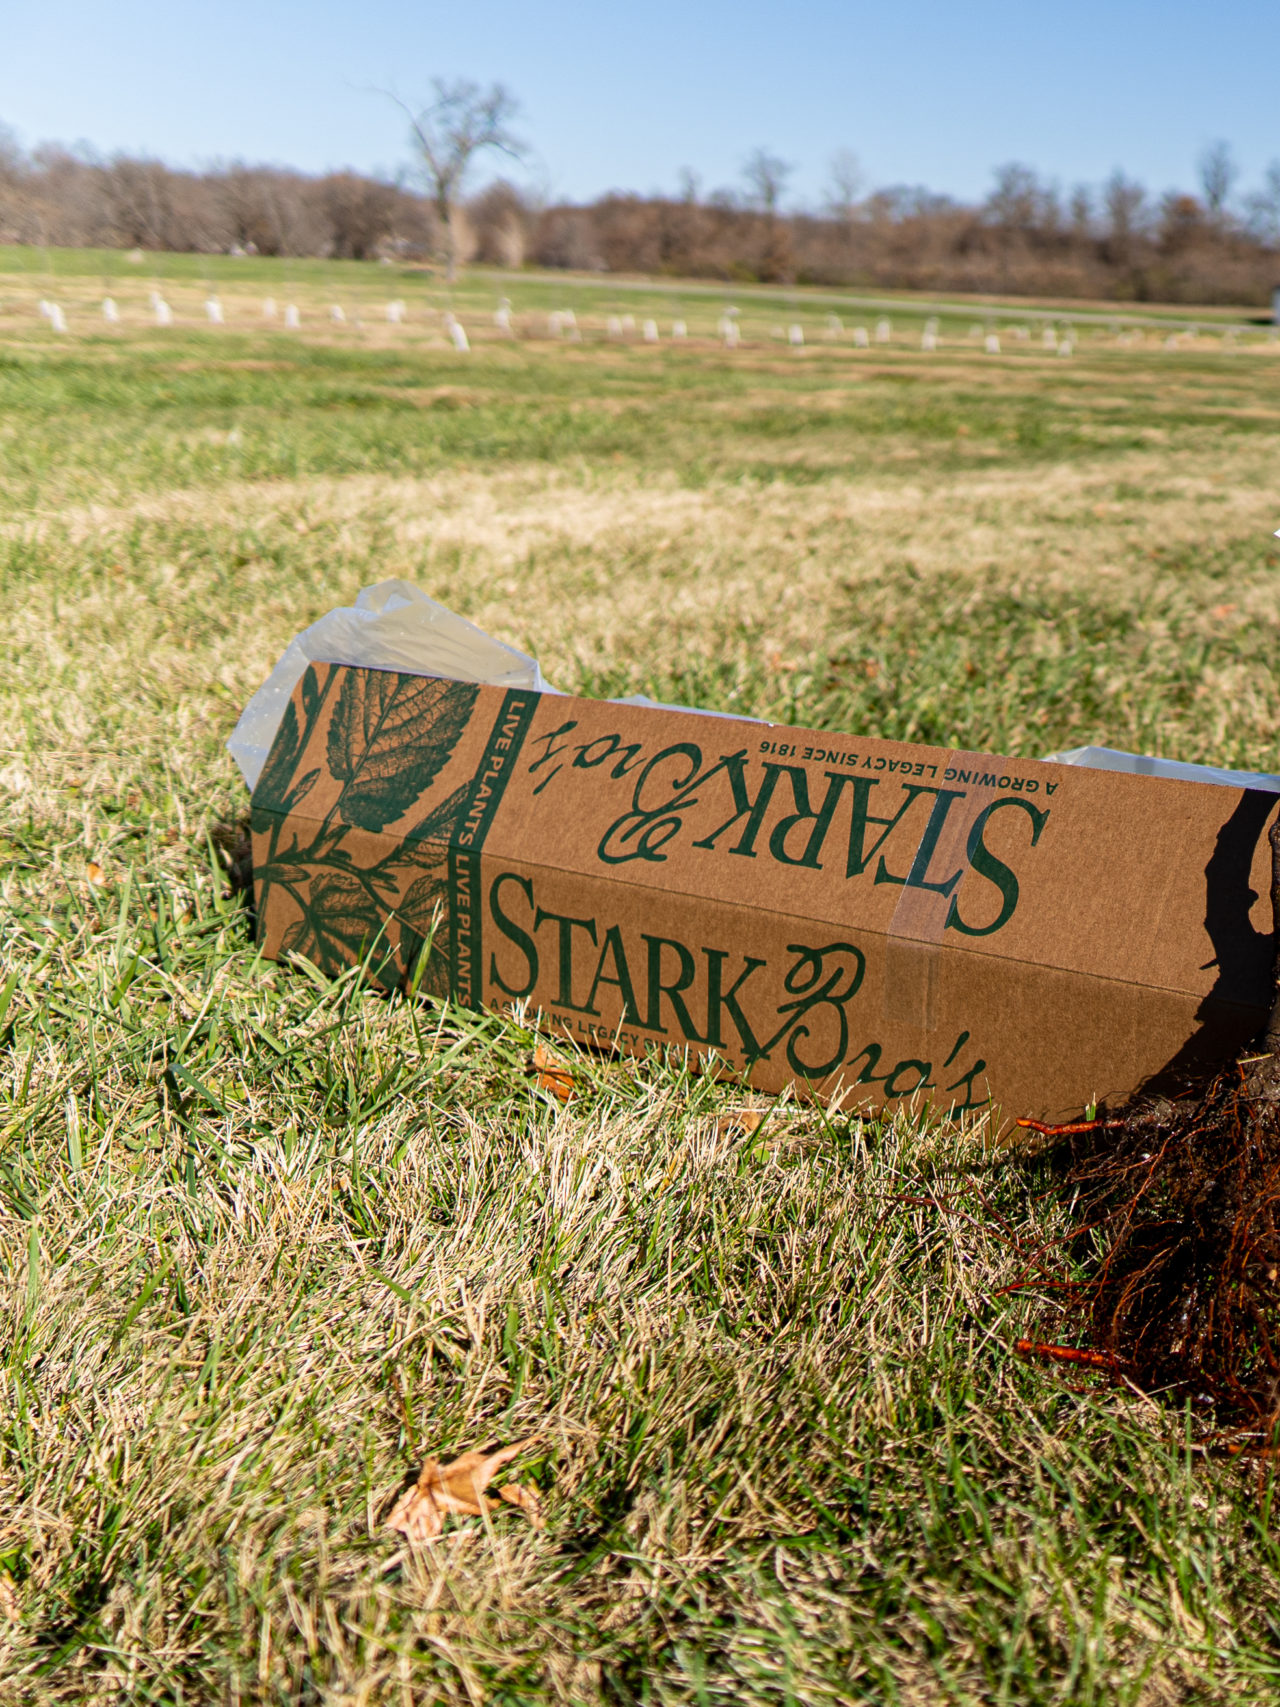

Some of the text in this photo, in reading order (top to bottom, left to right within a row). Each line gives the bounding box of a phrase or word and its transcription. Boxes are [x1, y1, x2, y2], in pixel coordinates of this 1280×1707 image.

[459, 701, 525, 846] LIVE PLANTS
[692, 749, 1050, 936] STARK
[759, 741, 1059, 796] A GROWING LEGACY SINCE 1816
[456, 854, 472, 1007] LIVE PLANTS
[489, 872, 770, 1061] STARK
[578, 1020, 639, 1047] LEGACY
